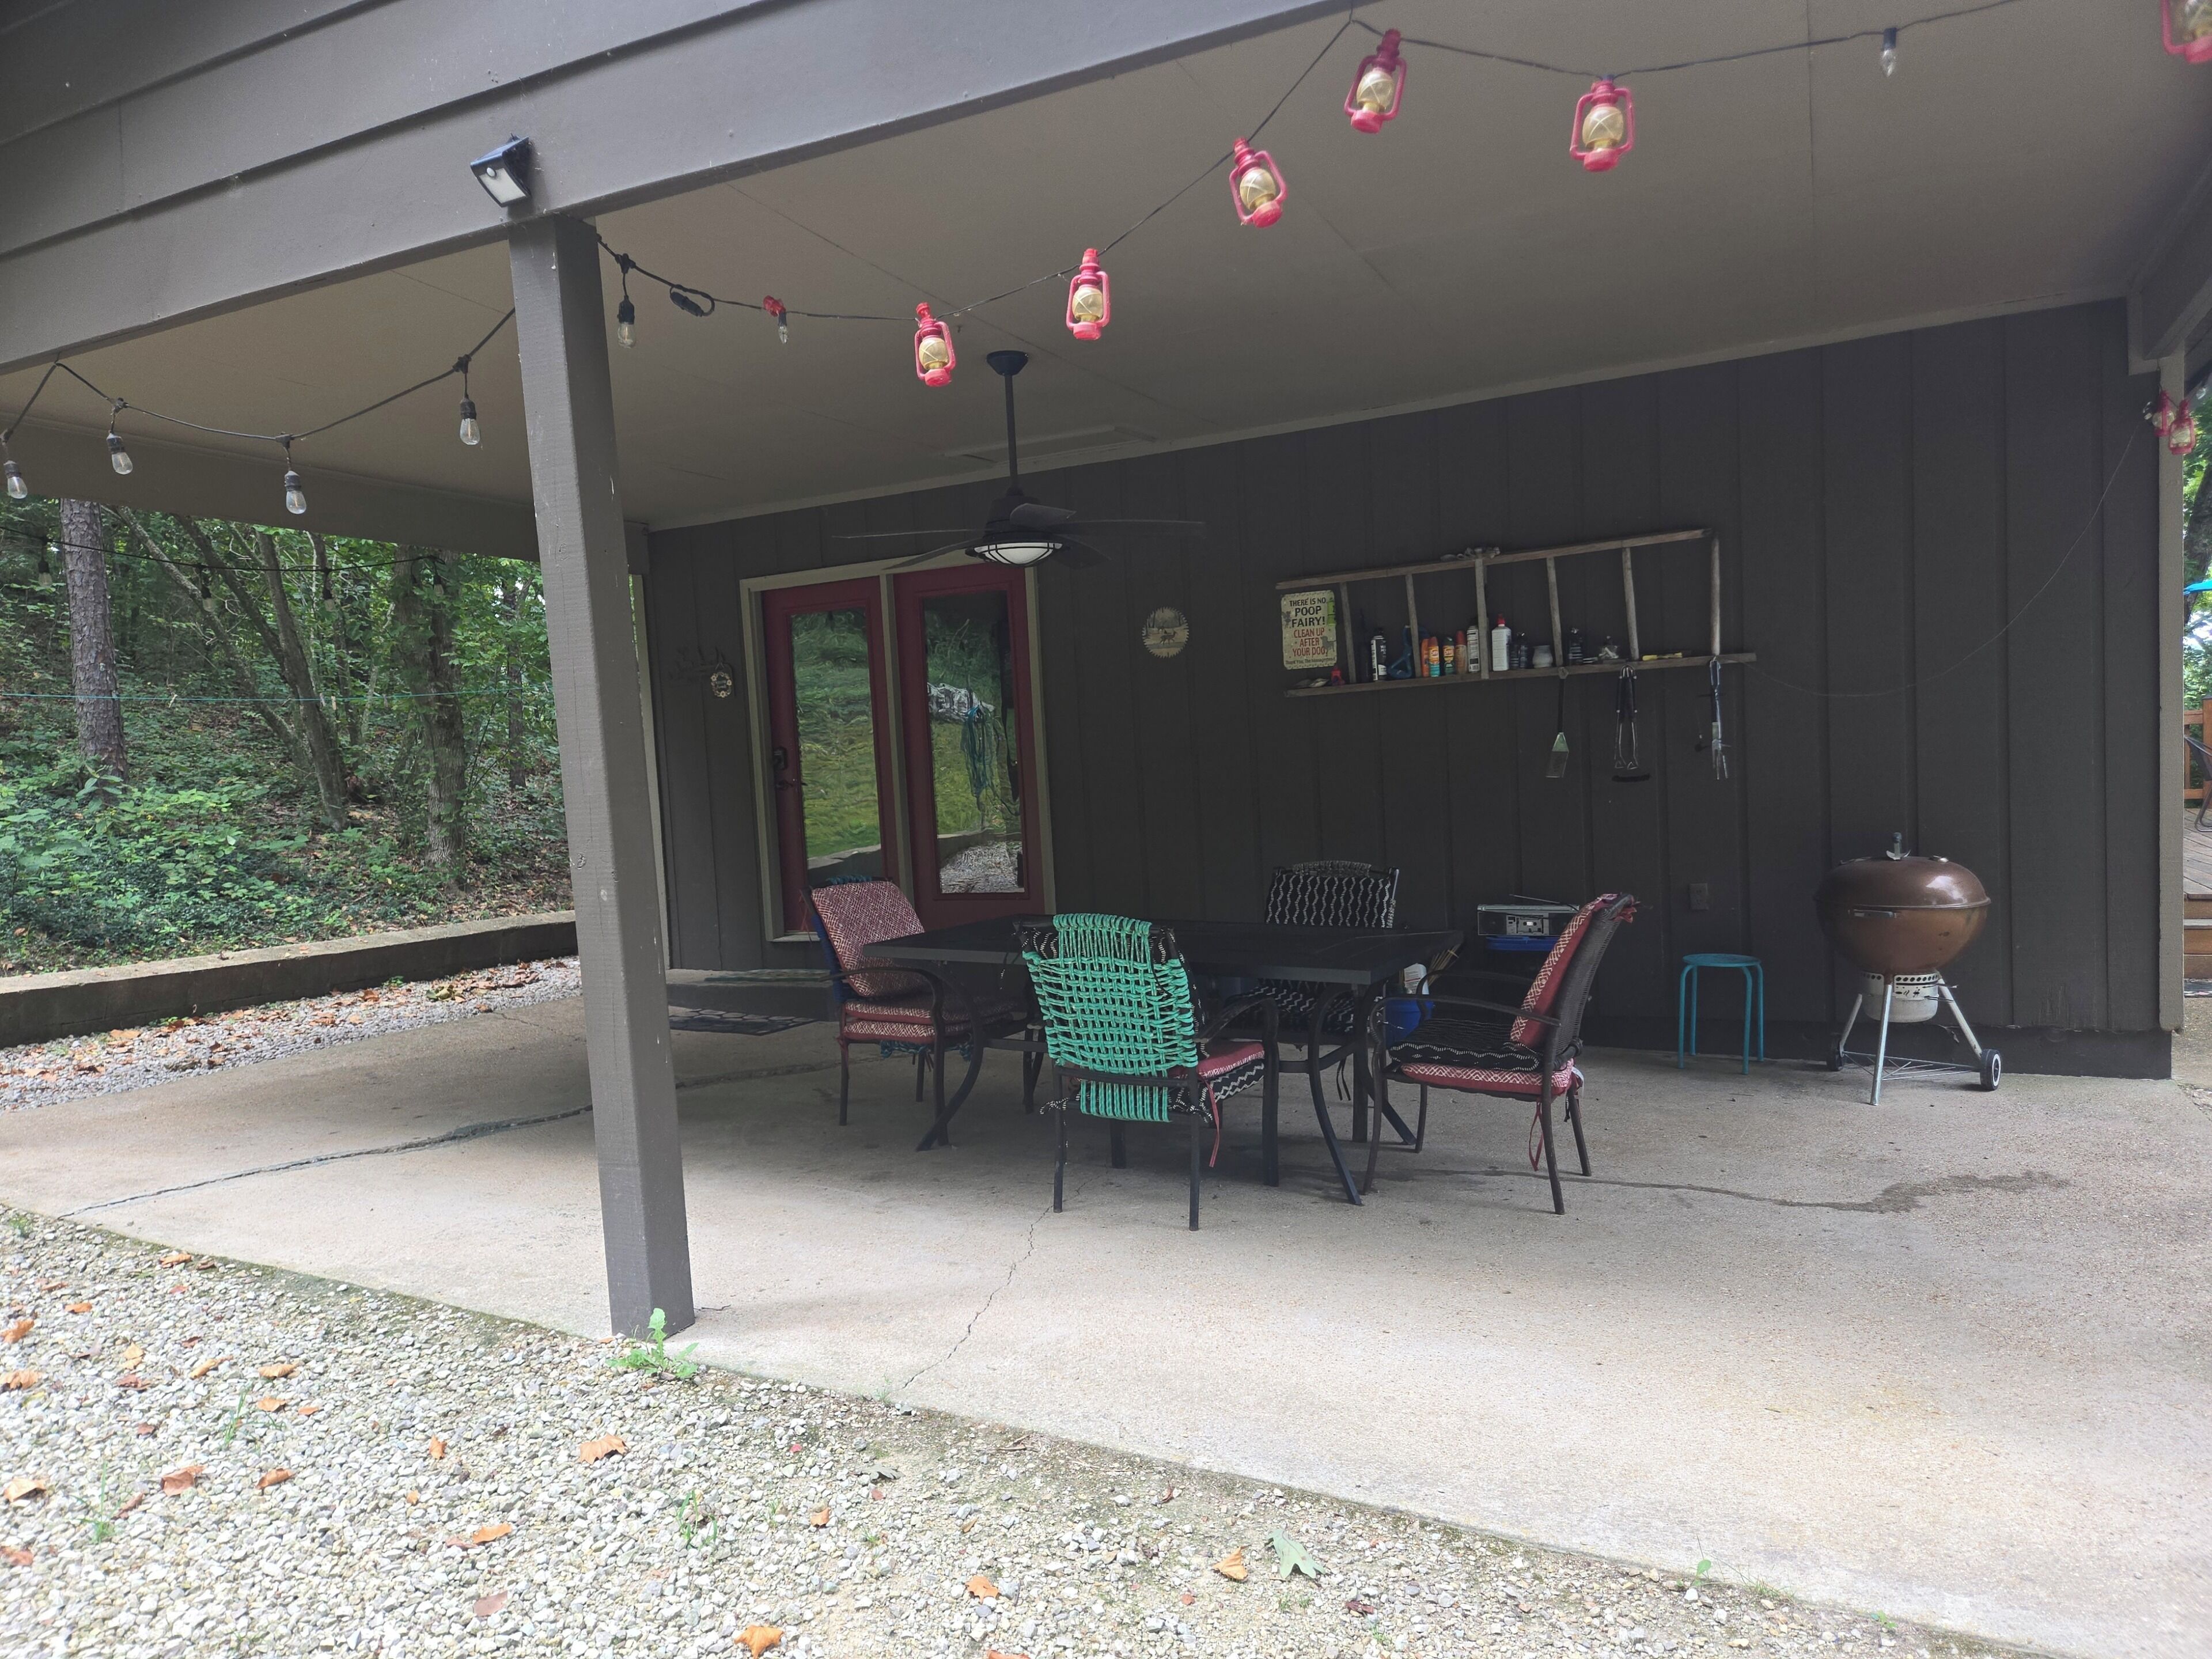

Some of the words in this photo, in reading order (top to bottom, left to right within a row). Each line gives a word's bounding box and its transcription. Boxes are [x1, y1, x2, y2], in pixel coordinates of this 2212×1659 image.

[1289, 599, 1308, 607] THERE
[1294, 605, 1321, 617] POOP
[1291, 616, 1325, 627] FAIRY!
[1293, 628, 1315, 638] CLEAN
[1316, 627, 1324, 636] UP
[1300, 638, 1319, 647] AFTER
[1293, 647, 1310, 657] YOUR
